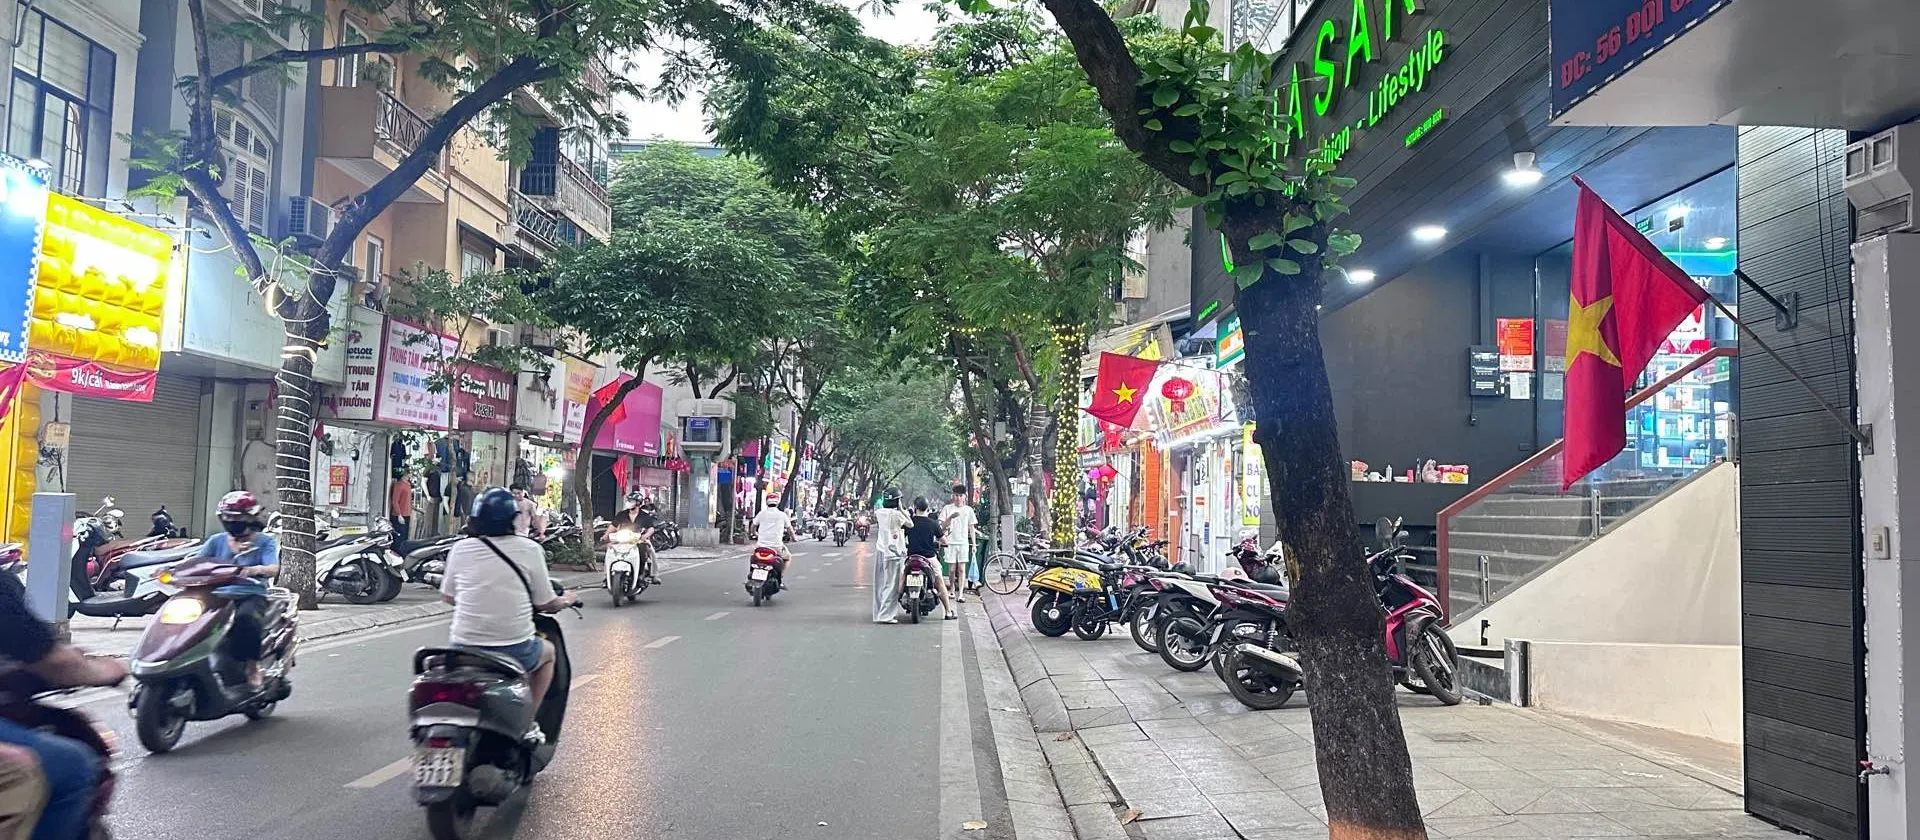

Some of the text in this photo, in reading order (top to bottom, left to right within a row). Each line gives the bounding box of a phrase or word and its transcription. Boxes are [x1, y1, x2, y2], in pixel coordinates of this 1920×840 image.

[1595, 25, 1621, 64] 56
[1368, 28, 1444, 128] Lifestyle
[71, 367, 103, 389] 9k/cái
[487, 379, 510, 401] NAM
